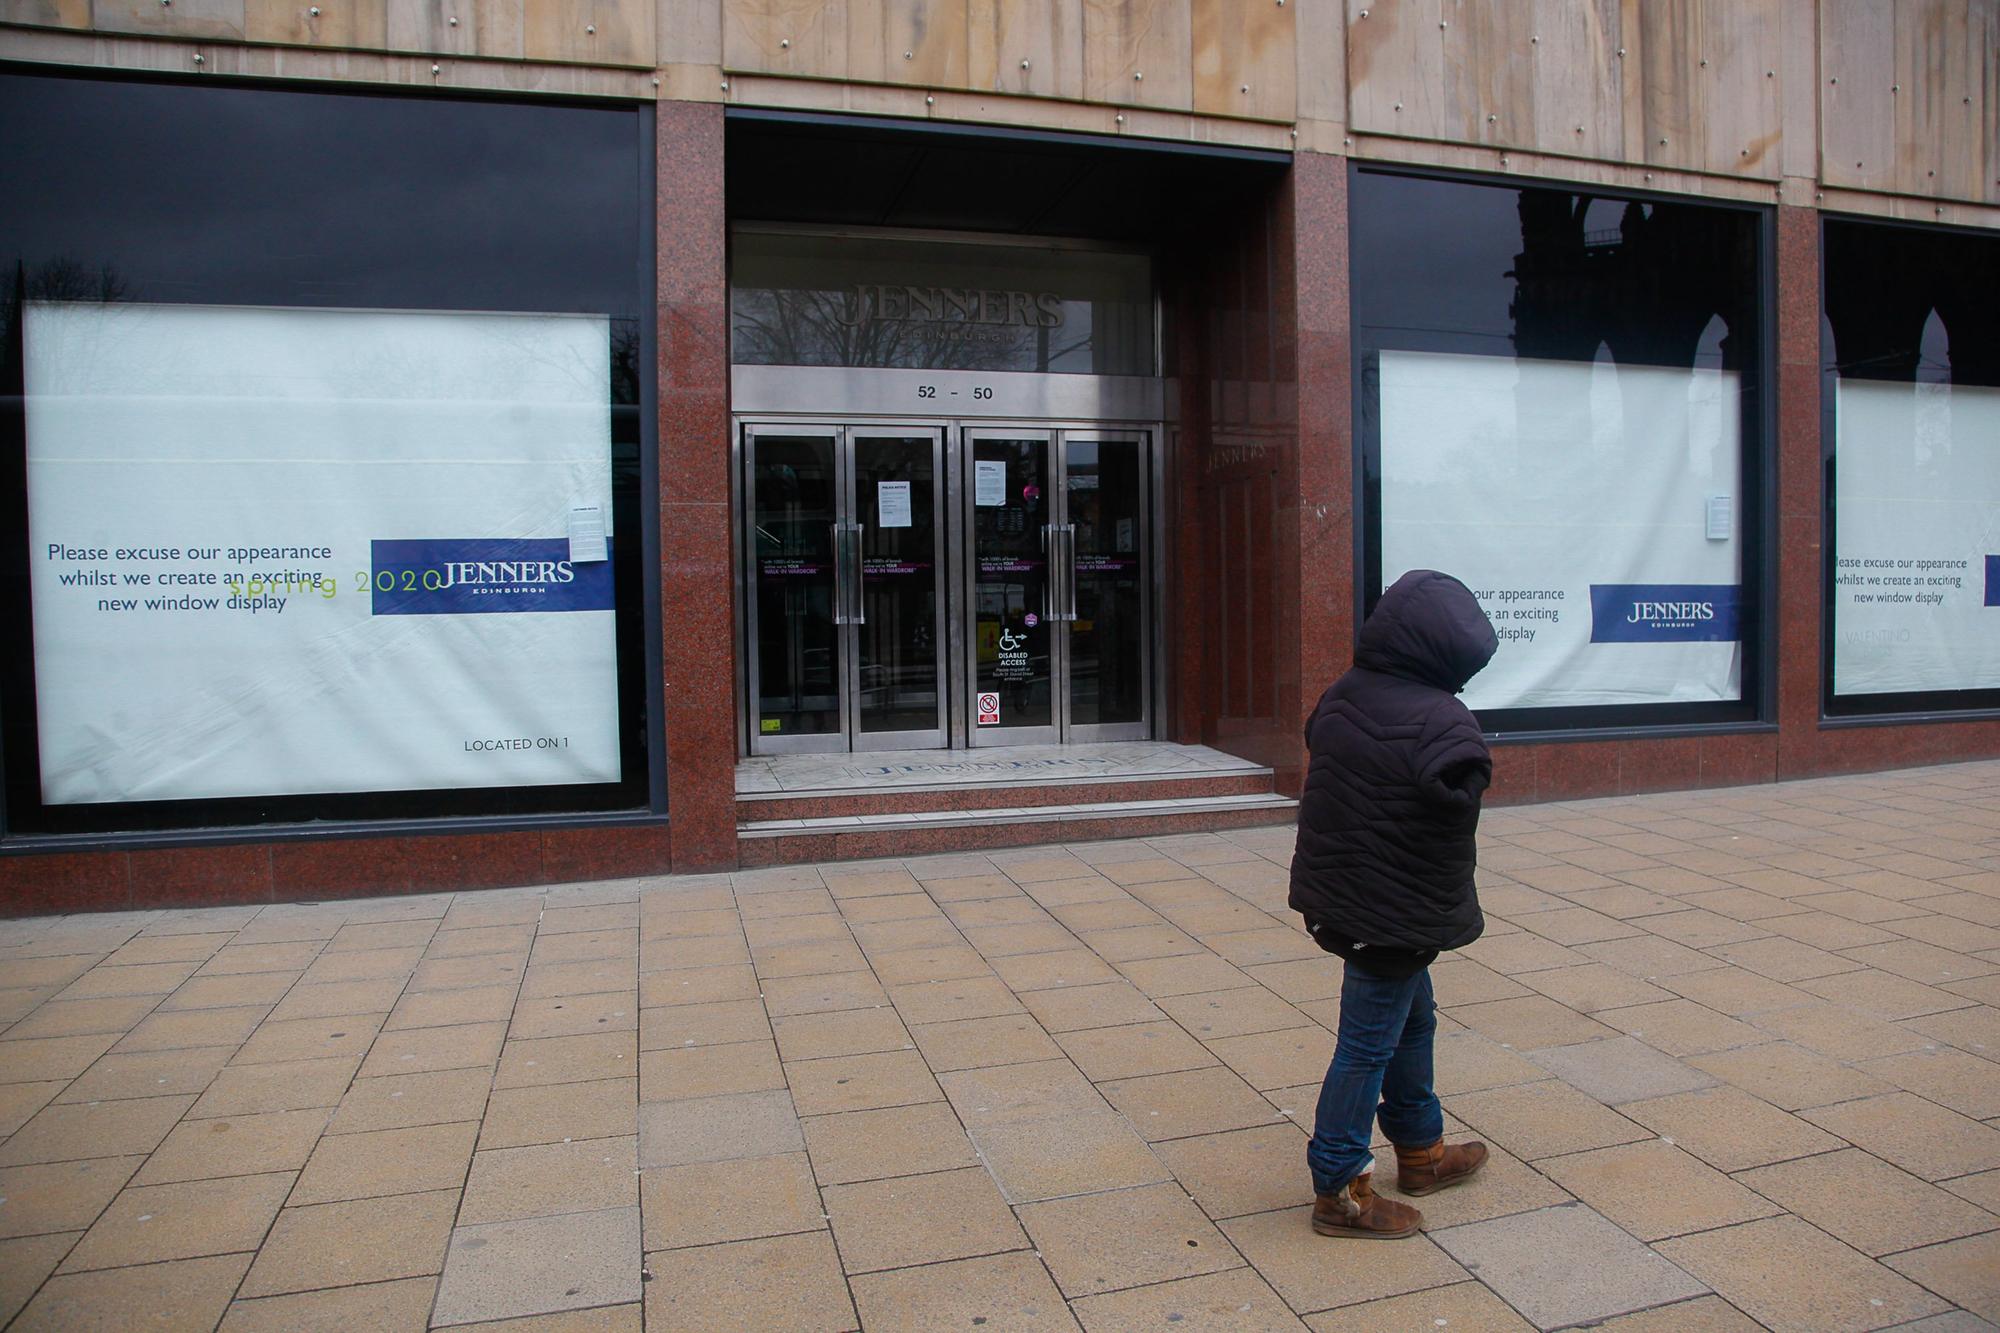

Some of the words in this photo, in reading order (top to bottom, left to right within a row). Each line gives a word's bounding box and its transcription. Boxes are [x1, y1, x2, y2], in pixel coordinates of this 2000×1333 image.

[834, 284, 1065, 328] JENNERS
[899, 331, 1016, 343] EDINBURGH
[918, 385, 936, 399] 52
[973, 387, 993, 400] 50
[48, 543, 108, 560] Please
[115, 548, 181, 560] excuse
[187, 548, 221, 560] our
[227, 547, 332, 564] appearance
[1836, 555, 1861, 568] lease
[1864, 558, 1894, 568] excuse
[1897, 559, 1914, 568] our
[1916, 559, 1967, 571] appearance
[59, 569, 117, 586] whilst
[123, 573, 151, 585] we
[157, 572, 217, 585] create
[223, 573, 245, 585] an
[251, 569, 322, 589] exciting
[436, 561, 575, 589] JENNERS
[1836, 574, 1864, 586] whilst
[1867, 577, 1880, 585] we
[1883, 576, 1911, 586] create
[1914, 577, 1925, 586] an
[1927, 574, 1961, 588] exciting
[230, 575, 337, 599] spring
[355, 569, 441, 592] 2020
[98, 599, 138, 611] new
[144, 593, 220, 611] window
[226, 593, 287, 614] display
[1474, 589, 1495, 600] our
[1498, 589, 1565, 604] appearance
[1854, 594, 1874, 603] new
[1877, 591, 1912, 603] window
[1915, 591, 1944, 606] display
[1495, 610, 1509, 620] an
[1513, 607, 1559, 622] exciting
[1627, 602, 1714, 623] JENNERS
[1497, 626, 1536, 642] display
[1845, 628, 1911, 644] VALENTINO
[464, 738, 532, 752] LOCATED
[536, 737, 558, 749] ON
[563, 737, 569, 748] 1
